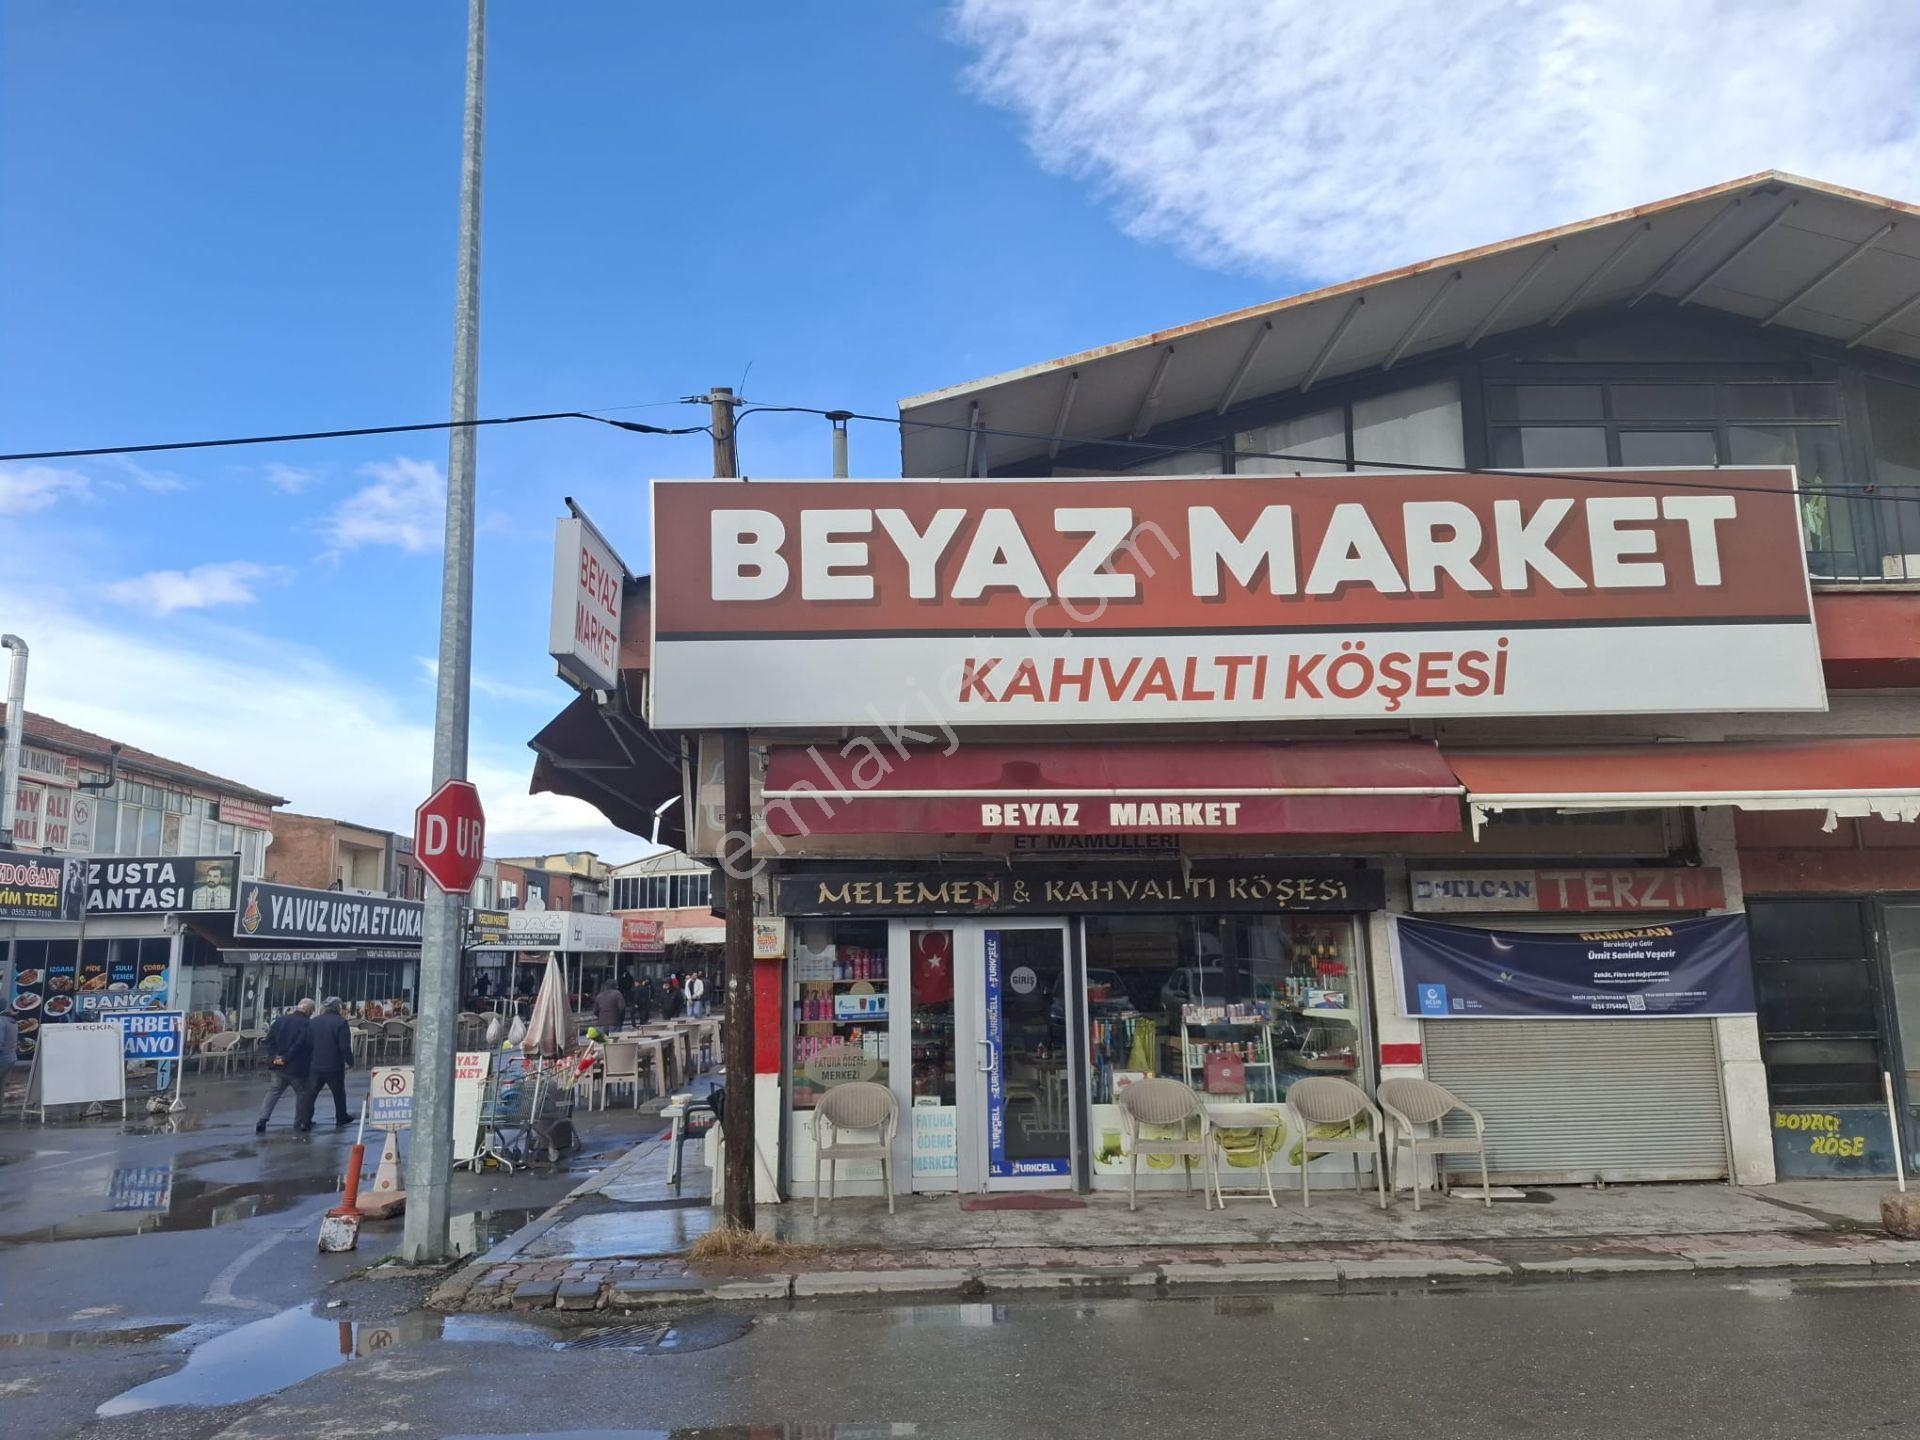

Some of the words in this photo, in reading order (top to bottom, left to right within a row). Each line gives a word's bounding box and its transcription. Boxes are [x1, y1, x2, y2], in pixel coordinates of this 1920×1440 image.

[711, 507, 1137, 601] BEYAZ
[1187, 495, 1738, 598] MARKET
[580, 546, 619, 618] BEYAZ
[575, 600, 618, 669] MARKET
[959, 654, 1267, 703] KAHVALTI
[1284, 637, 1510, 711] KÖŞESİ
[981, 804, 1079, 827] BEYAZ
[1109, 803, 1241, 826] MARKET
[425, 814, 481, 860] DUR
[107, 862, 176, 885] USTA
[817, 880, 1001, 904] MELEMEN
[1013, 880, 1031, 903] &
[1046, 878, 1216, 902] KAHVALTI
[1228, 874, 1348, 907] KÖŞESİ
[1539, 870, 1686, 908] TERZİ
[25, 891, 58, 908] TERZİ
[86, 887, 184, 910] ANTASI
[271, 894, 329, 933] YAVUZ
[330, 902, 369, 935] USTA
[371, 906, 390, 936] ET
[389, 907, 423, 938] LOKA
[1579, 927, 1675, 942] RAMAZAN
[1603, 941, 1638, 949] Bereketiyle
[1638, 940, 1654, 948] Gelir
[1588, 950, 1611, 960] Ümit
[1611, 950, 1645, 960] Seninle
[1646, 949, 1677, 960] Yeşerir
[115, 964, 133, 972] SULU
[143, 964, 166, 972] ÇORBA
[112, 973, 135, 981] YEMEK
[1012, 974, 1035, 987] GİRİŞ
[75, 1024, 114, 1032] SEÇKİN
[124, 1035, 174, 1054] ANYO
[456, 1055, 480, 1066] YAZ
[814, 1056, 840, 1067] FATURA
[378, 1098, 410, 1108] BEYAZ
[373, 1110, 412, 1121] MARKET
[916, 1113, 953, 1128] FATURA
[992, 1106, 1002, 1150] TURKCELL
[917, 1131, 953, 1149] ÖDEME
[1015, 1164, 1057, 1174] TURKCELL
